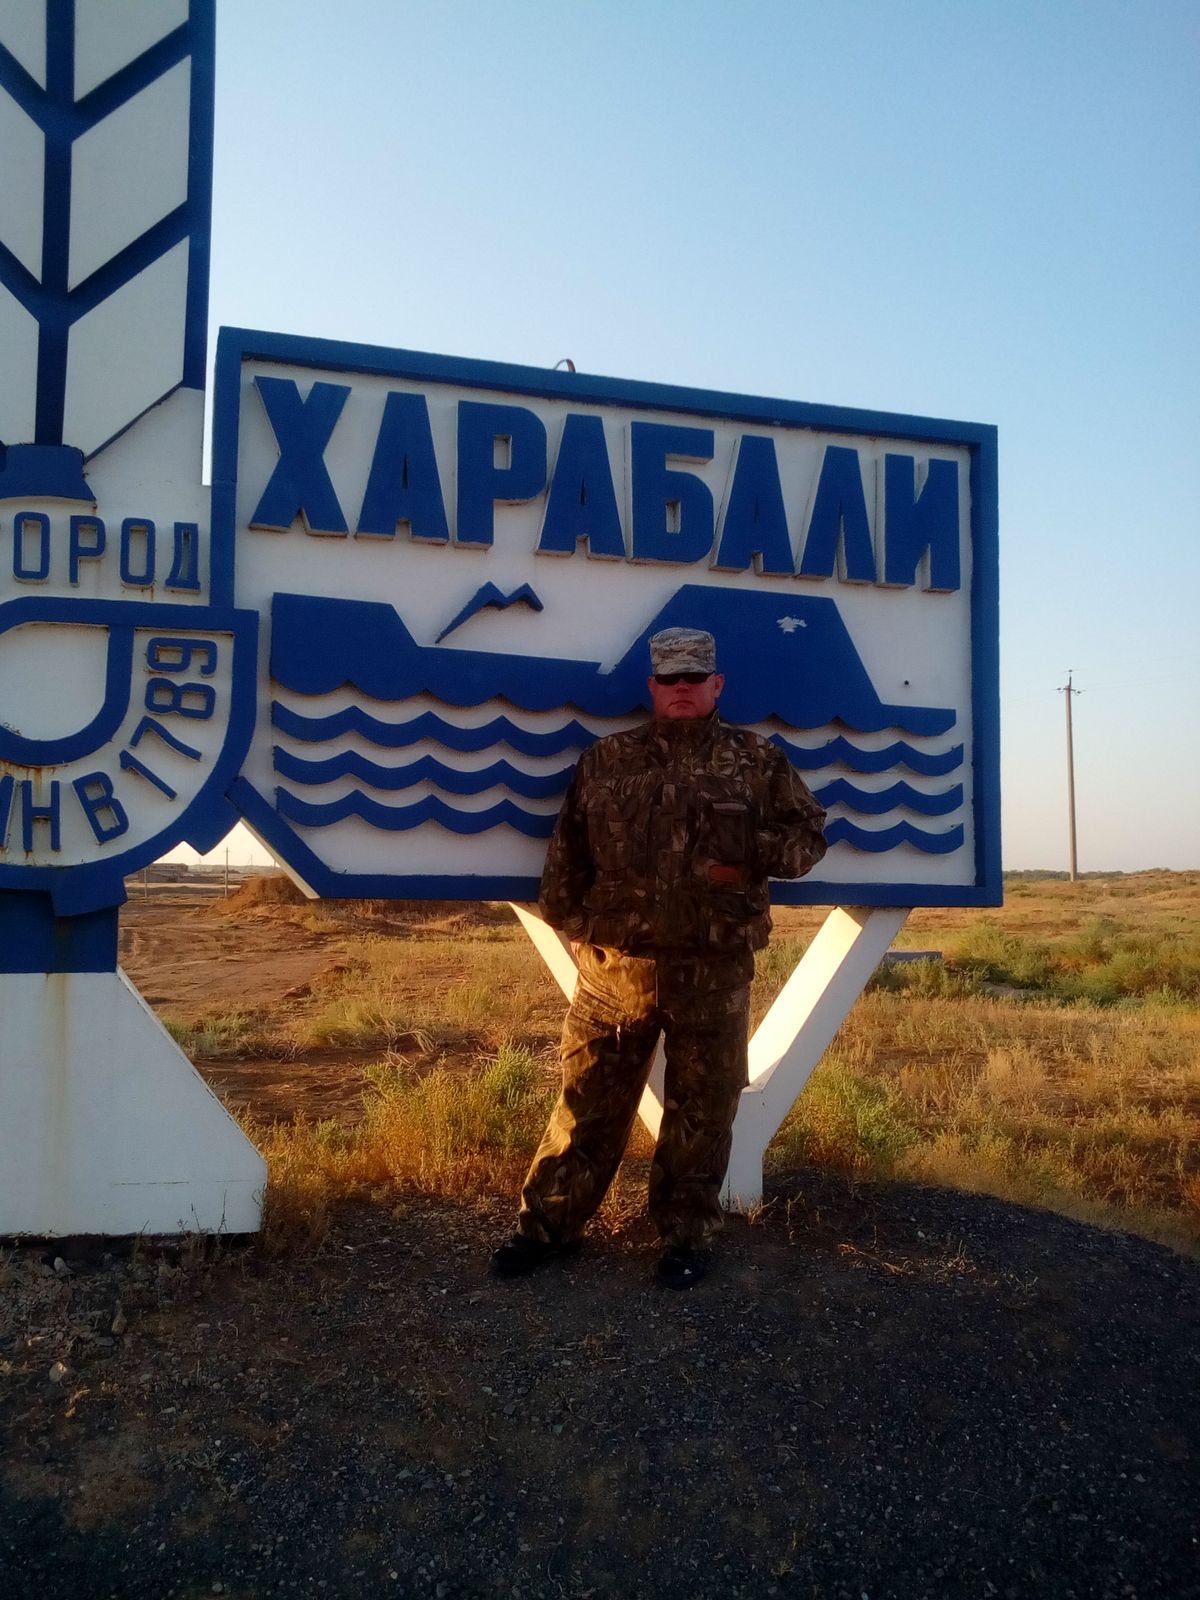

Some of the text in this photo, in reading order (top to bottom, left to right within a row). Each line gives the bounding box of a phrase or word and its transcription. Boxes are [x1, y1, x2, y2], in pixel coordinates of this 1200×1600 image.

[0, 511, 200, 590] ОРОД
[250, 375, 960, 592] ХАРАБАЛИ
[119, 636, 218, 800] 1789
